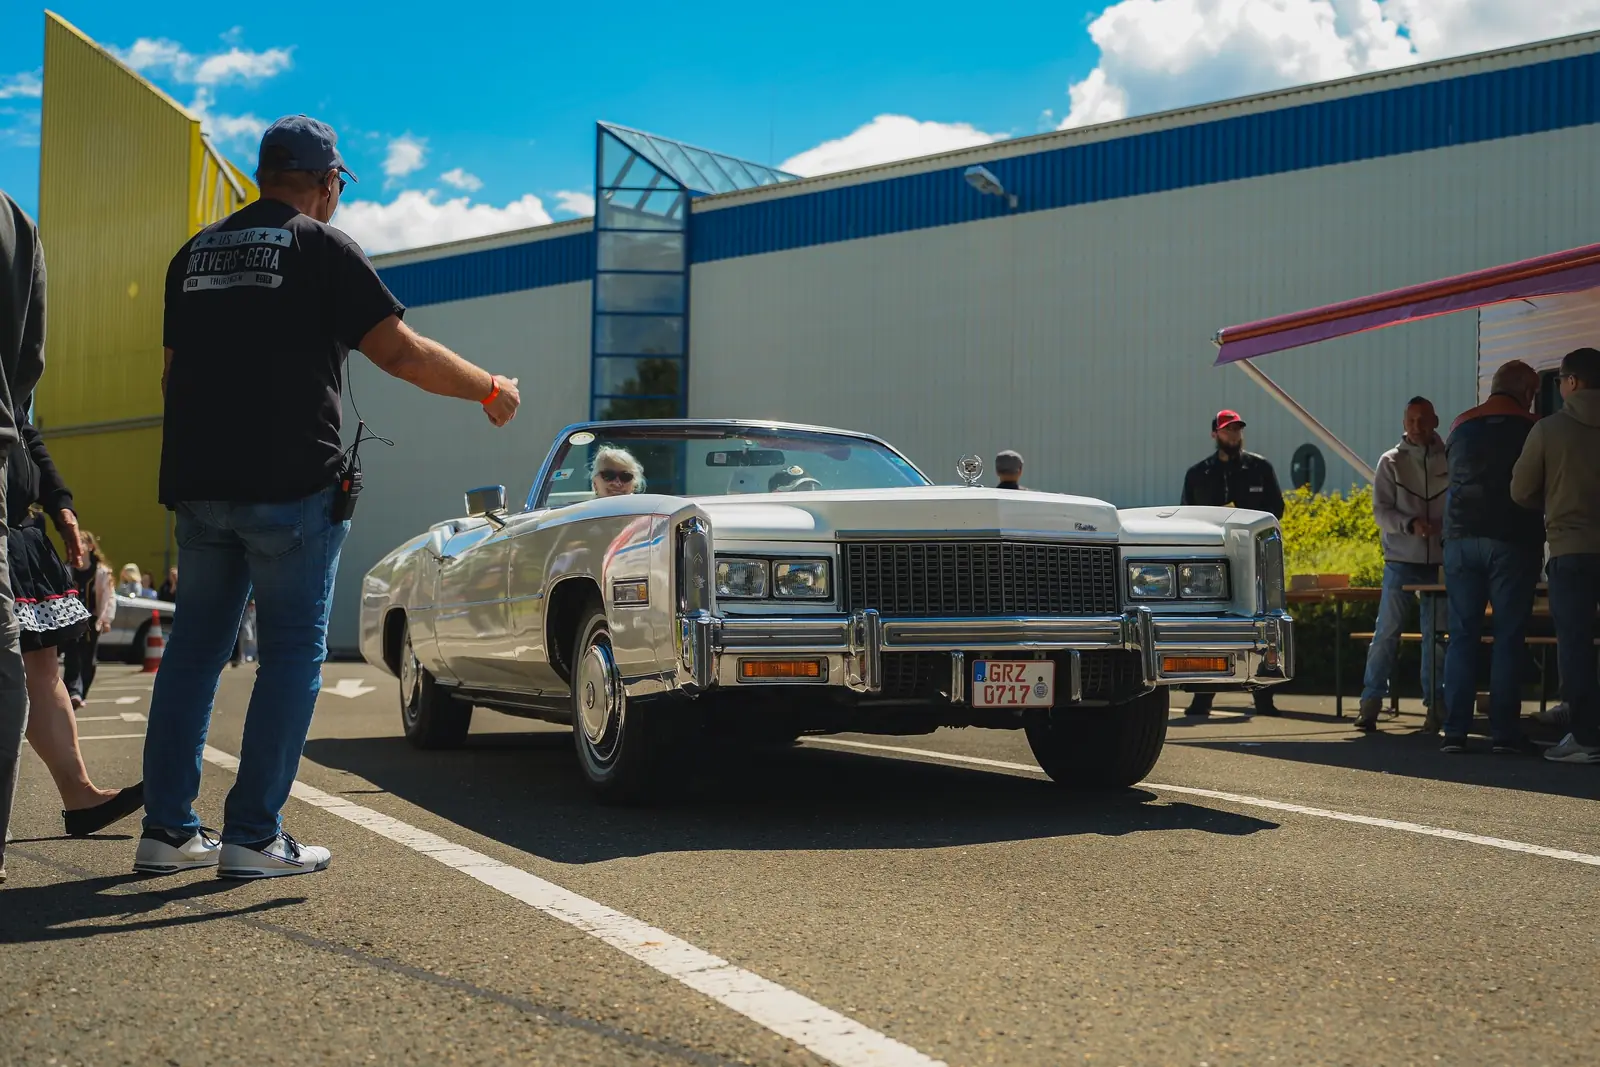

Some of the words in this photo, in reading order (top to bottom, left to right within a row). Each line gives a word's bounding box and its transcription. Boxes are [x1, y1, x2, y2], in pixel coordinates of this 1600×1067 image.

[219, 234, 232, 245] US
[237, 230, 256, 243] CAR
[186, 247, 280, 274] DRIVERS-GERA
[989, 664, 1026, 682] GRZ
[984, 685, 1030, 704] 0717
